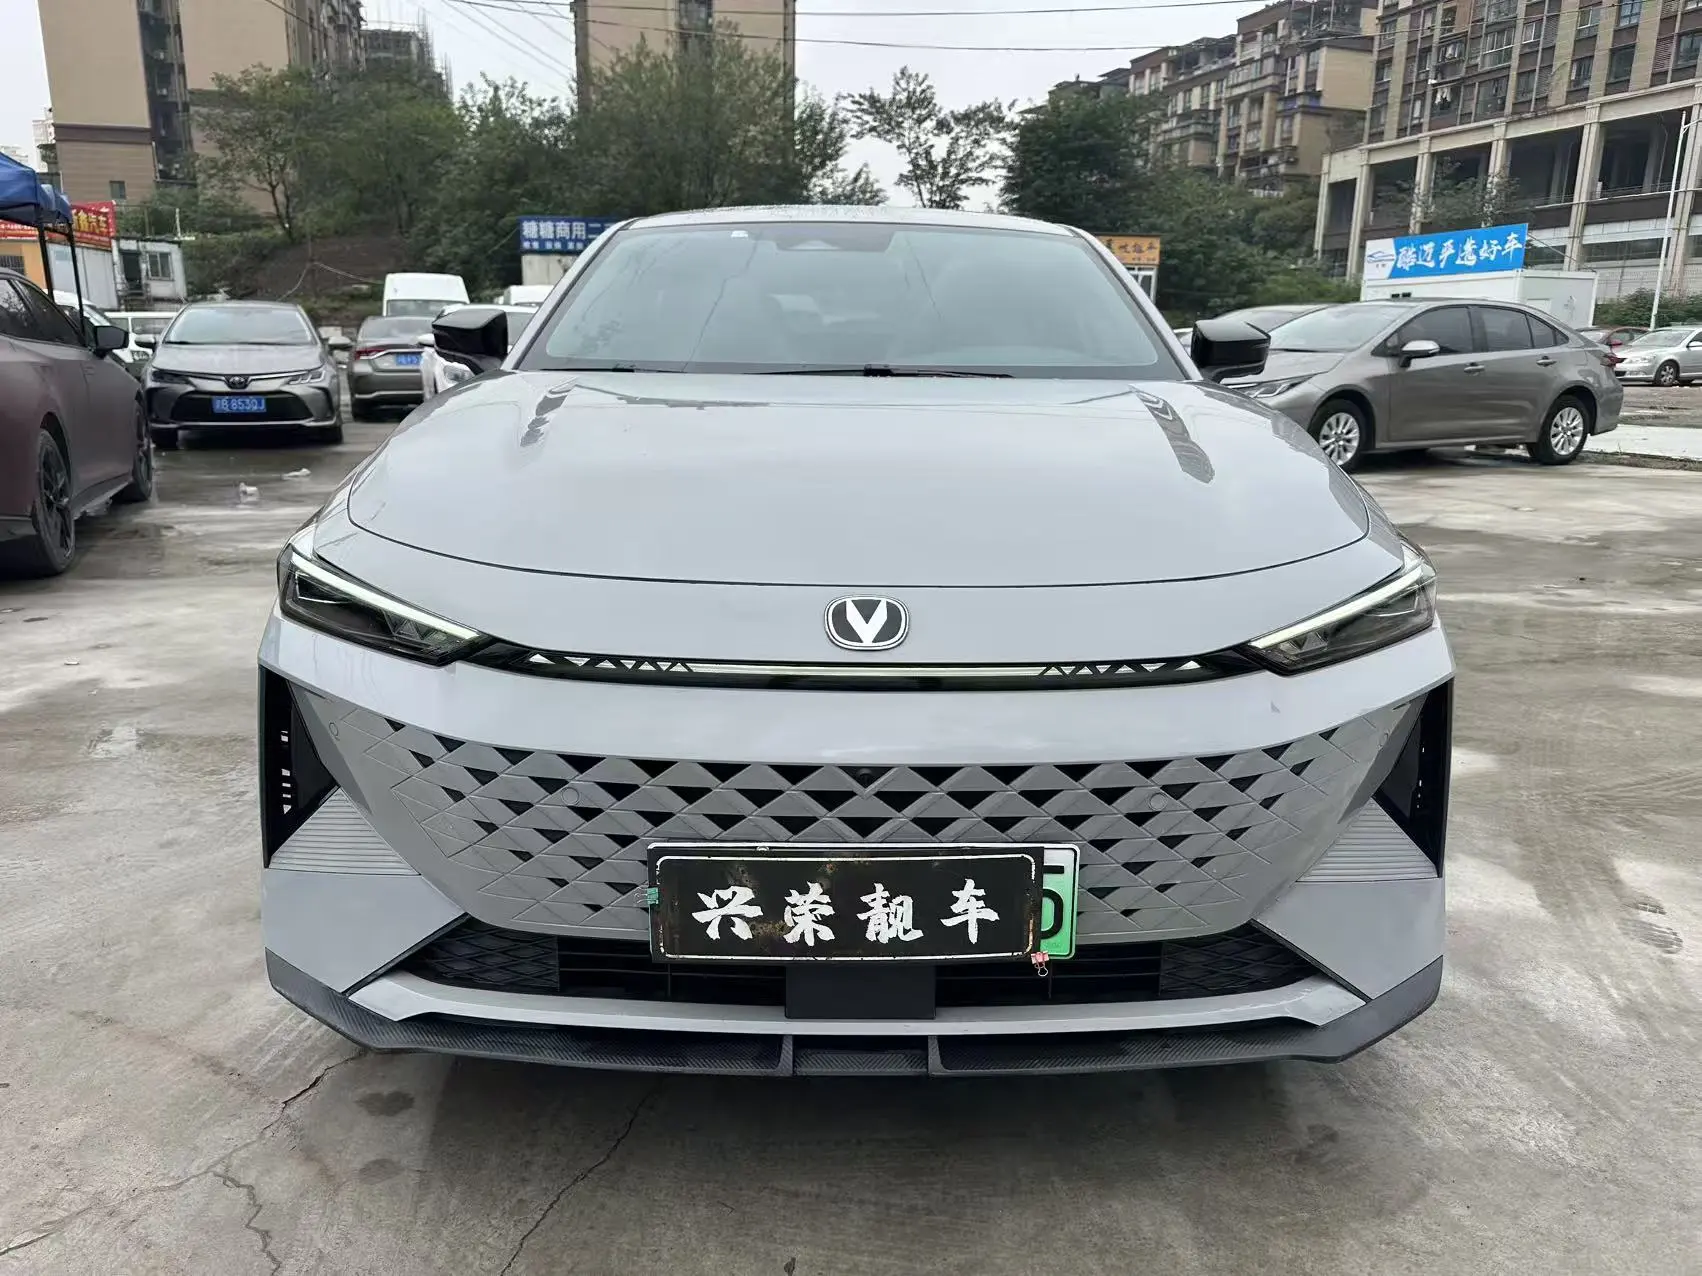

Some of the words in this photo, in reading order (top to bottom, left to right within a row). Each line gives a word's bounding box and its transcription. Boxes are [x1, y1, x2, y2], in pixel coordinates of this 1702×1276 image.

[522, 220, 614, 239] 糖糖商用二
[691, 879, 1000, 947] 兴荣靓车
